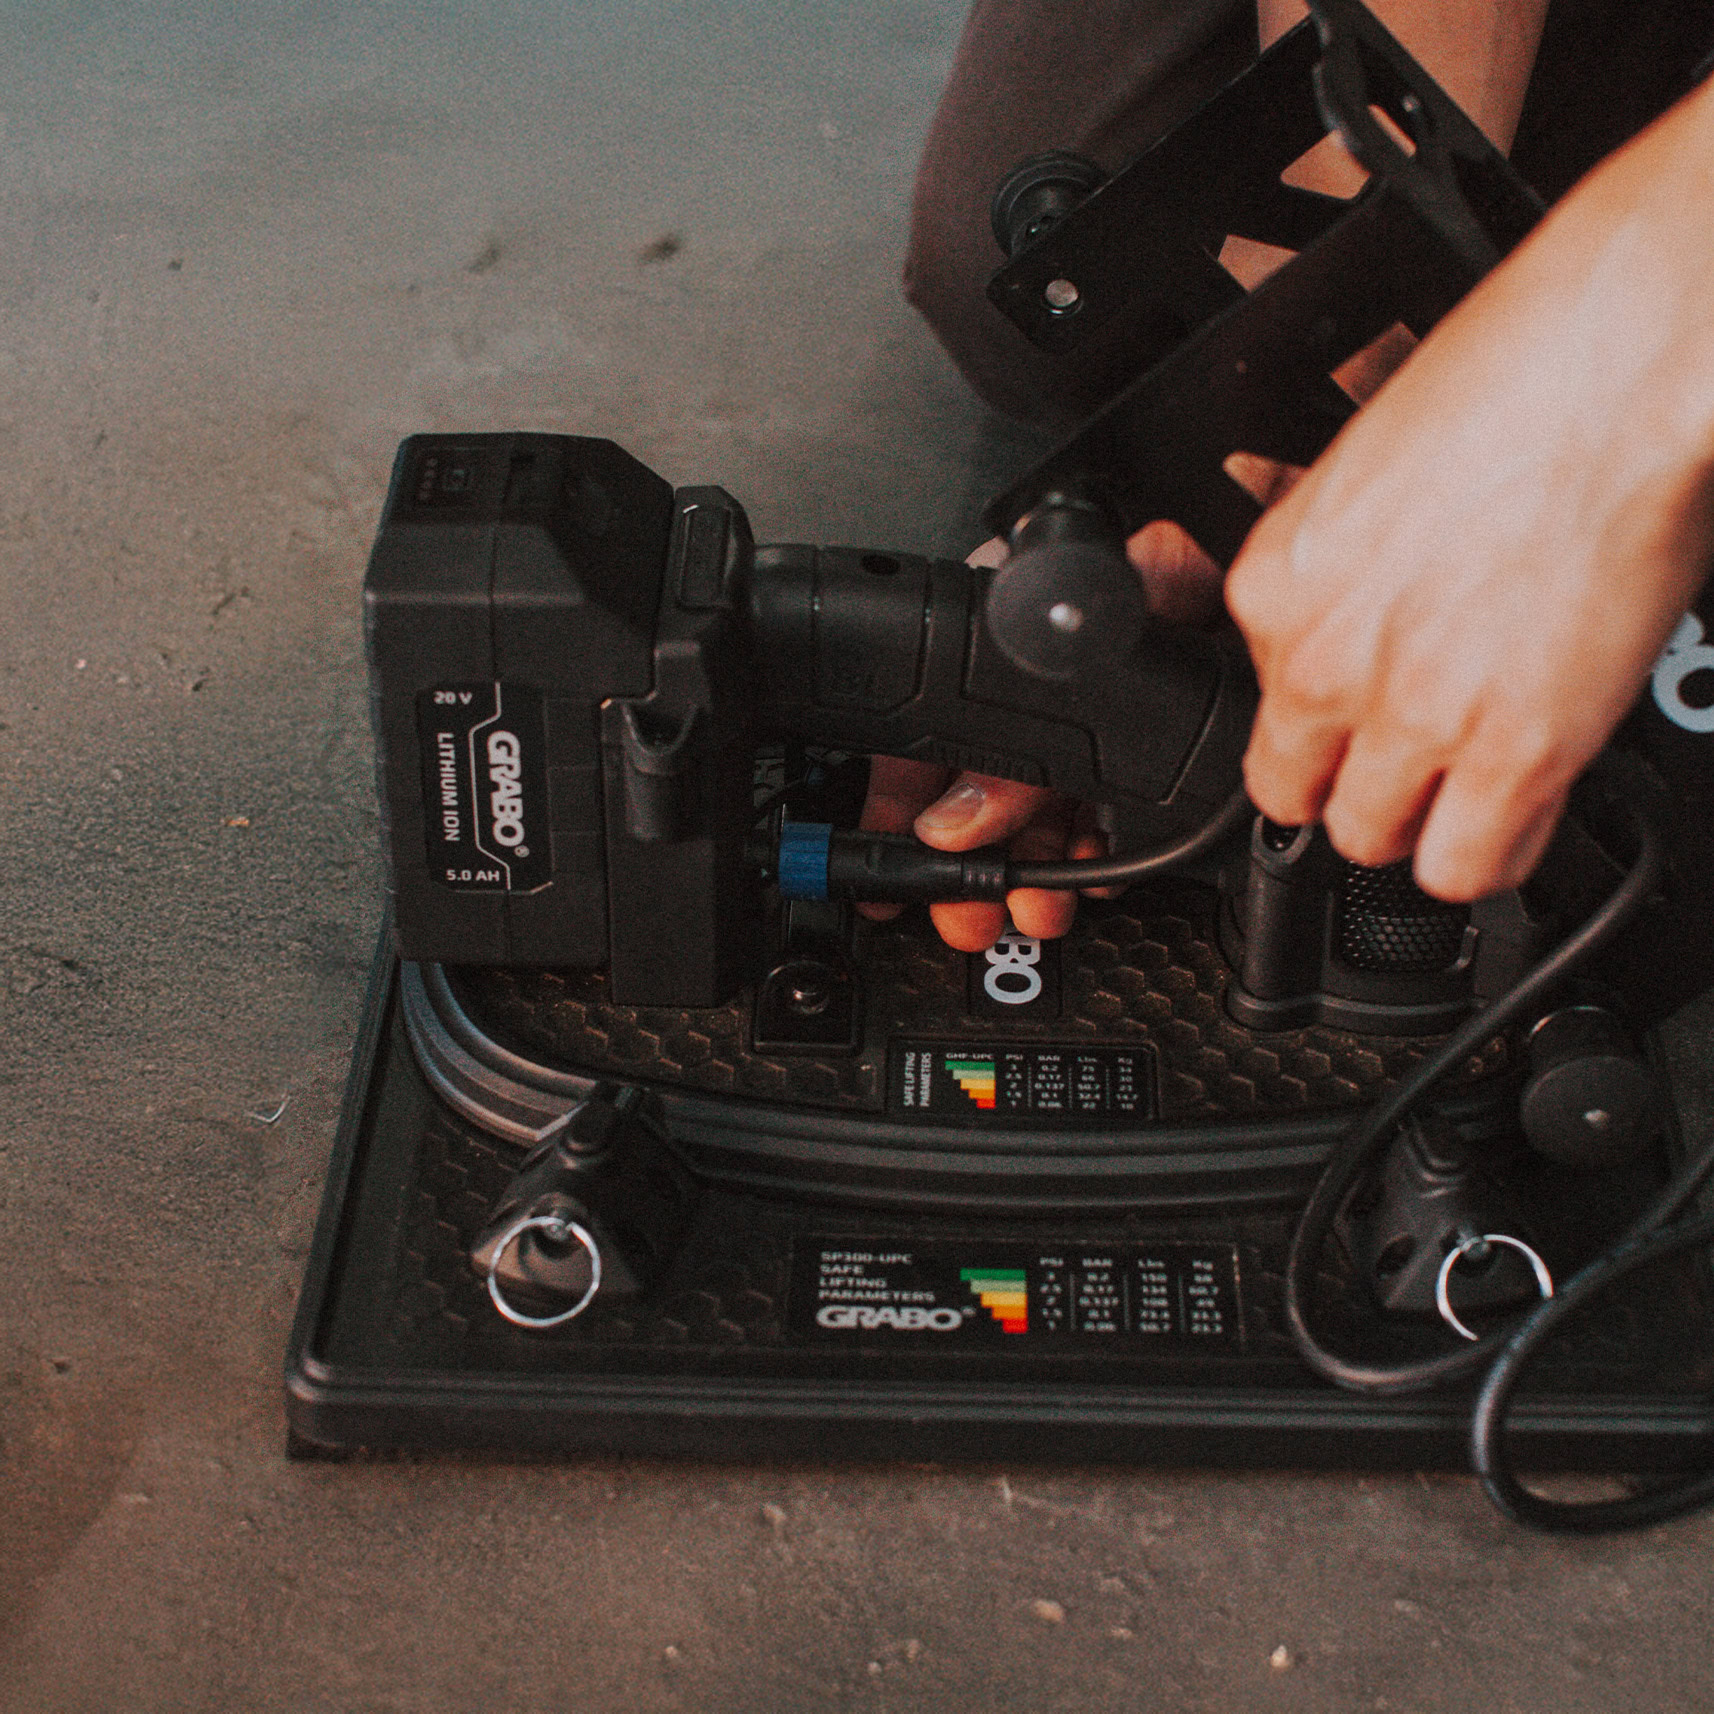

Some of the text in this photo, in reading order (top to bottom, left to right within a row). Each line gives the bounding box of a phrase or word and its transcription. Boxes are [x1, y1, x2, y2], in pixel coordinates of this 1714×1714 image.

[434, 691, 472, 705] 20 V
[438, 732, 460, 841] LITHIUM ION
[446, 869, 500, 881] 5.0 AH
[903, 1052, 916, 1107] SAFE LIFTING
[919, 1052, 932, 1107] PARAMETERS
[820, 1265, 864, 1275] SAFE
[819, 1277, 888, 1288] LIFTING
[818, 1289, 936, 1302] PARAMETERS
